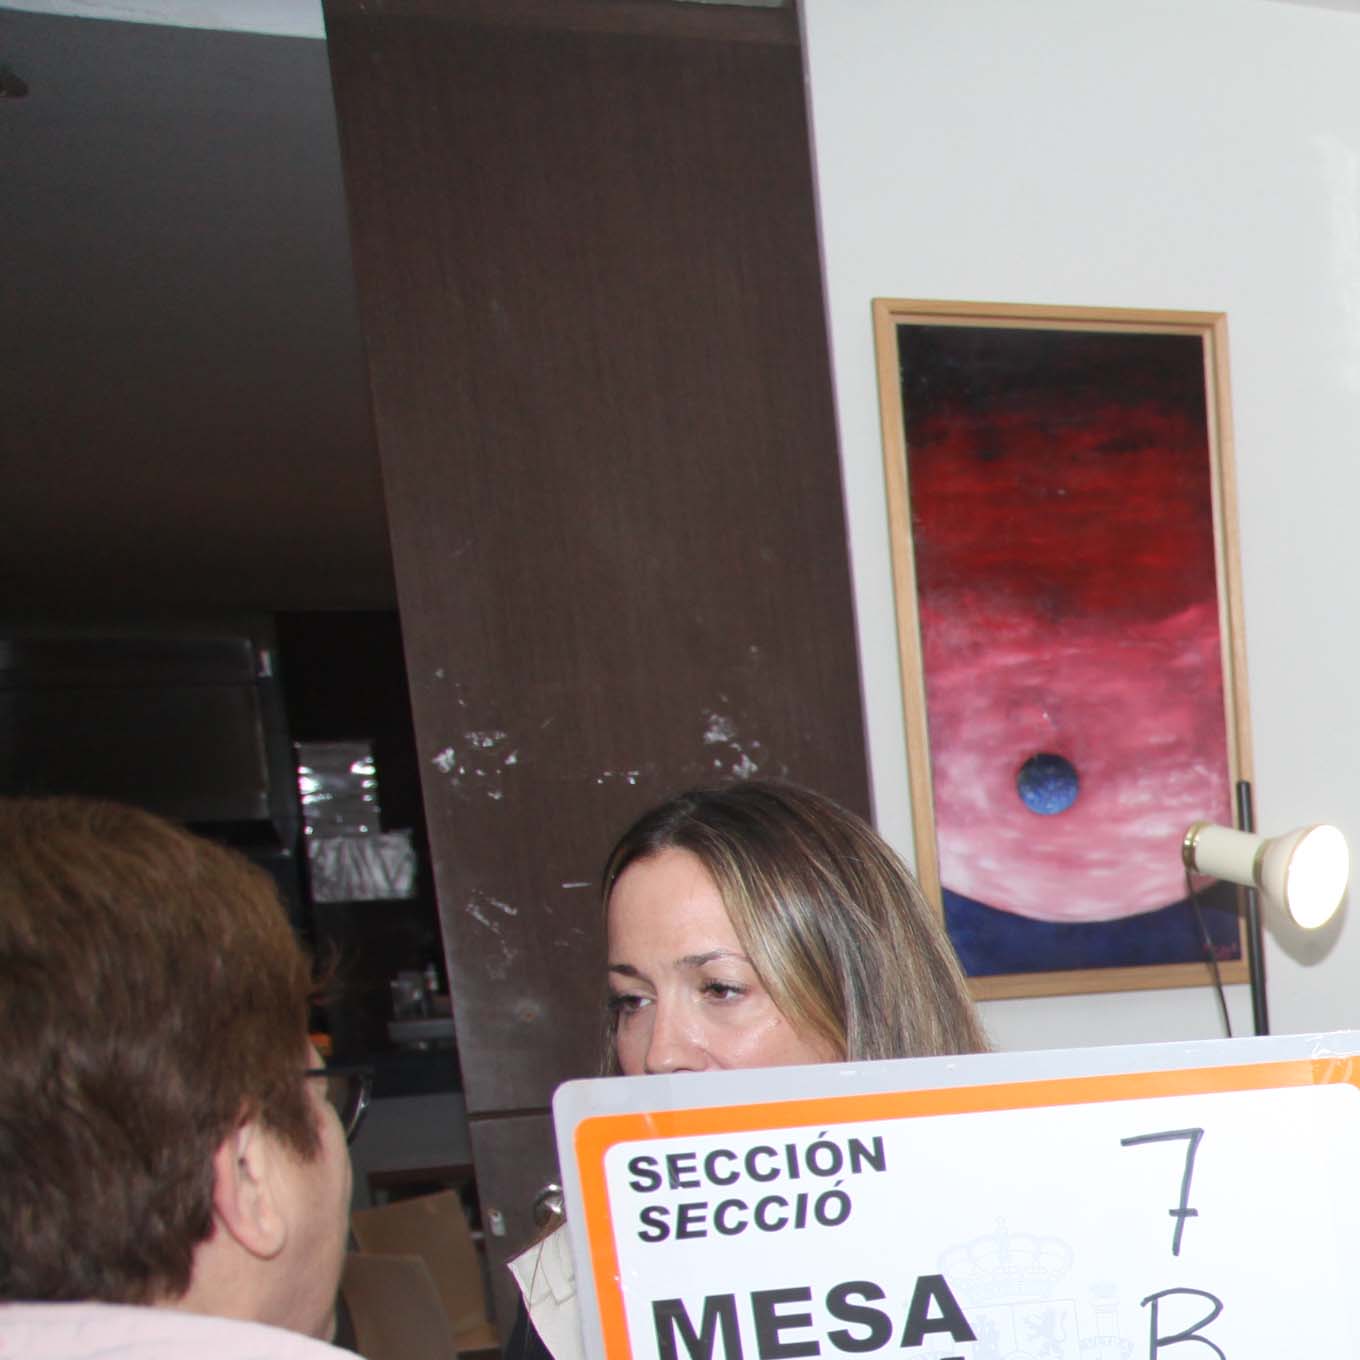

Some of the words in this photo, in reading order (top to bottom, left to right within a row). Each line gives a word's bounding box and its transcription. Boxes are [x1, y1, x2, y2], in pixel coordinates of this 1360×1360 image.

[627, 1131, 888, 1194] SECCIÓN
[1121, 1127, 1204, 1255] 7
[638, 1180, 853, 1243] SECCIÓ
